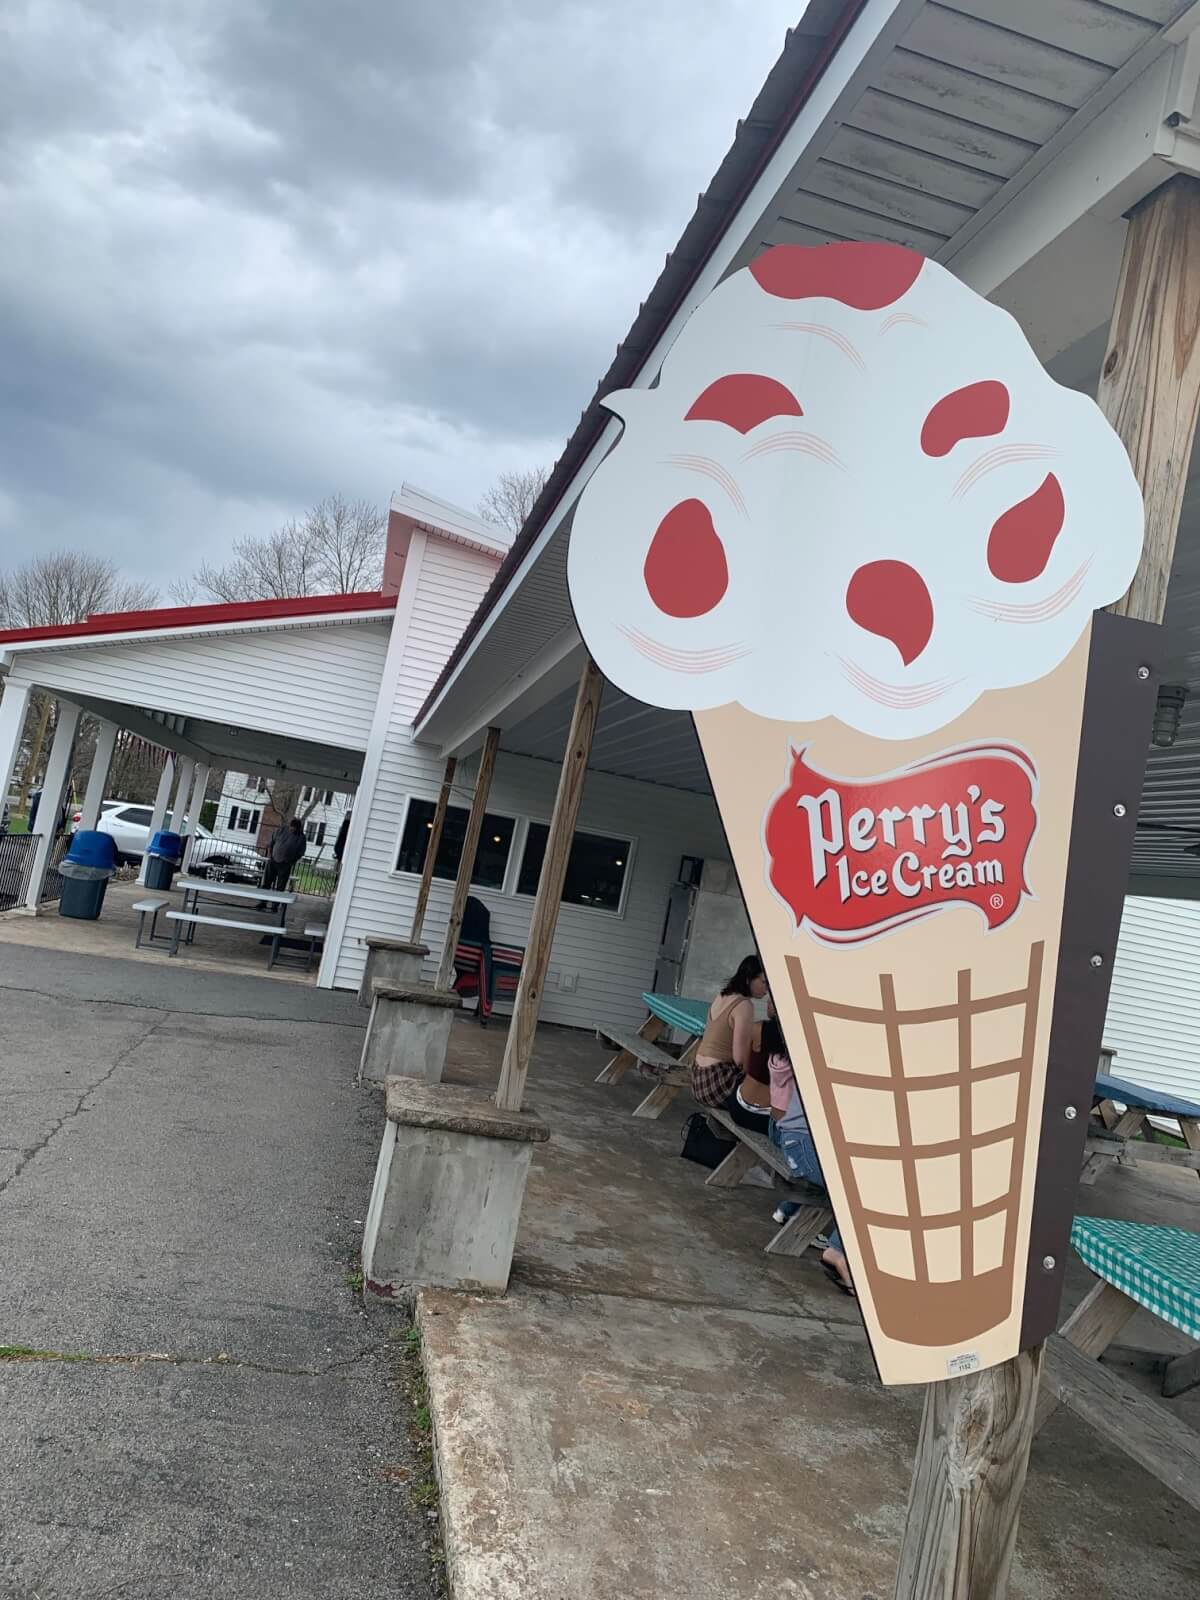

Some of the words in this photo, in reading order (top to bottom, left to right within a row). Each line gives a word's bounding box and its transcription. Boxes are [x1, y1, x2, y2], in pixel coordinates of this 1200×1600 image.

[797, 785, 1005, 888] Perry's
[835, 855, 889, 904] Ice
[892, 851, 1004, 897] Cream
